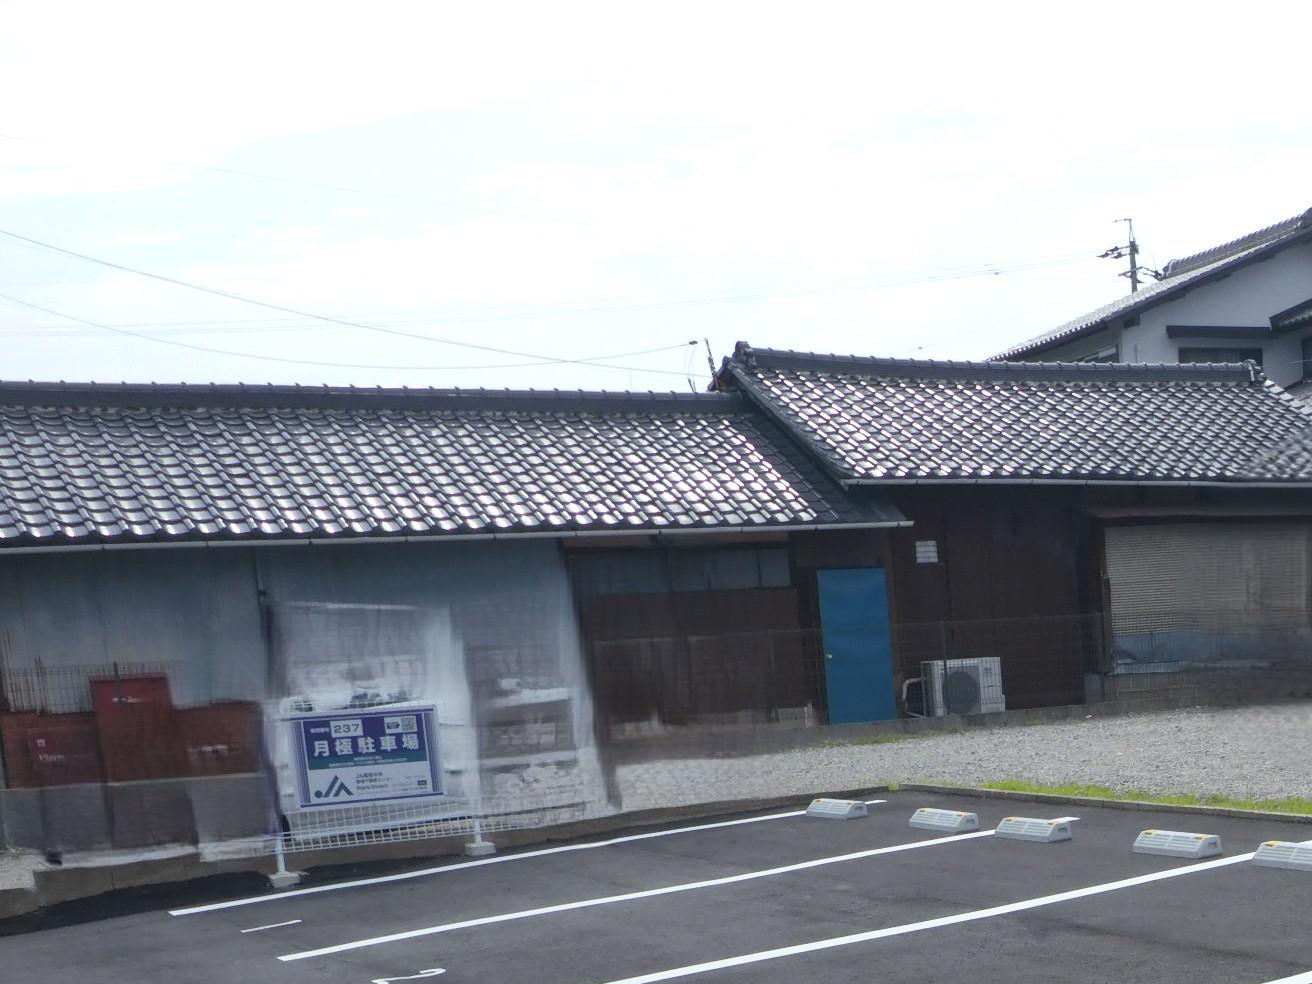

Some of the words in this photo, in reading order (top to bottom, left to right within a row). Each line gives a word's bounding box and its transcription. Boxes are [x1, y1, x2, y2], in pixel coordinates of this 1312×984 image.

[334, 723, 360, 734] 237
[313, 733, 420, 757] 月極駐車場
[371, 967, 446, 984] 2
